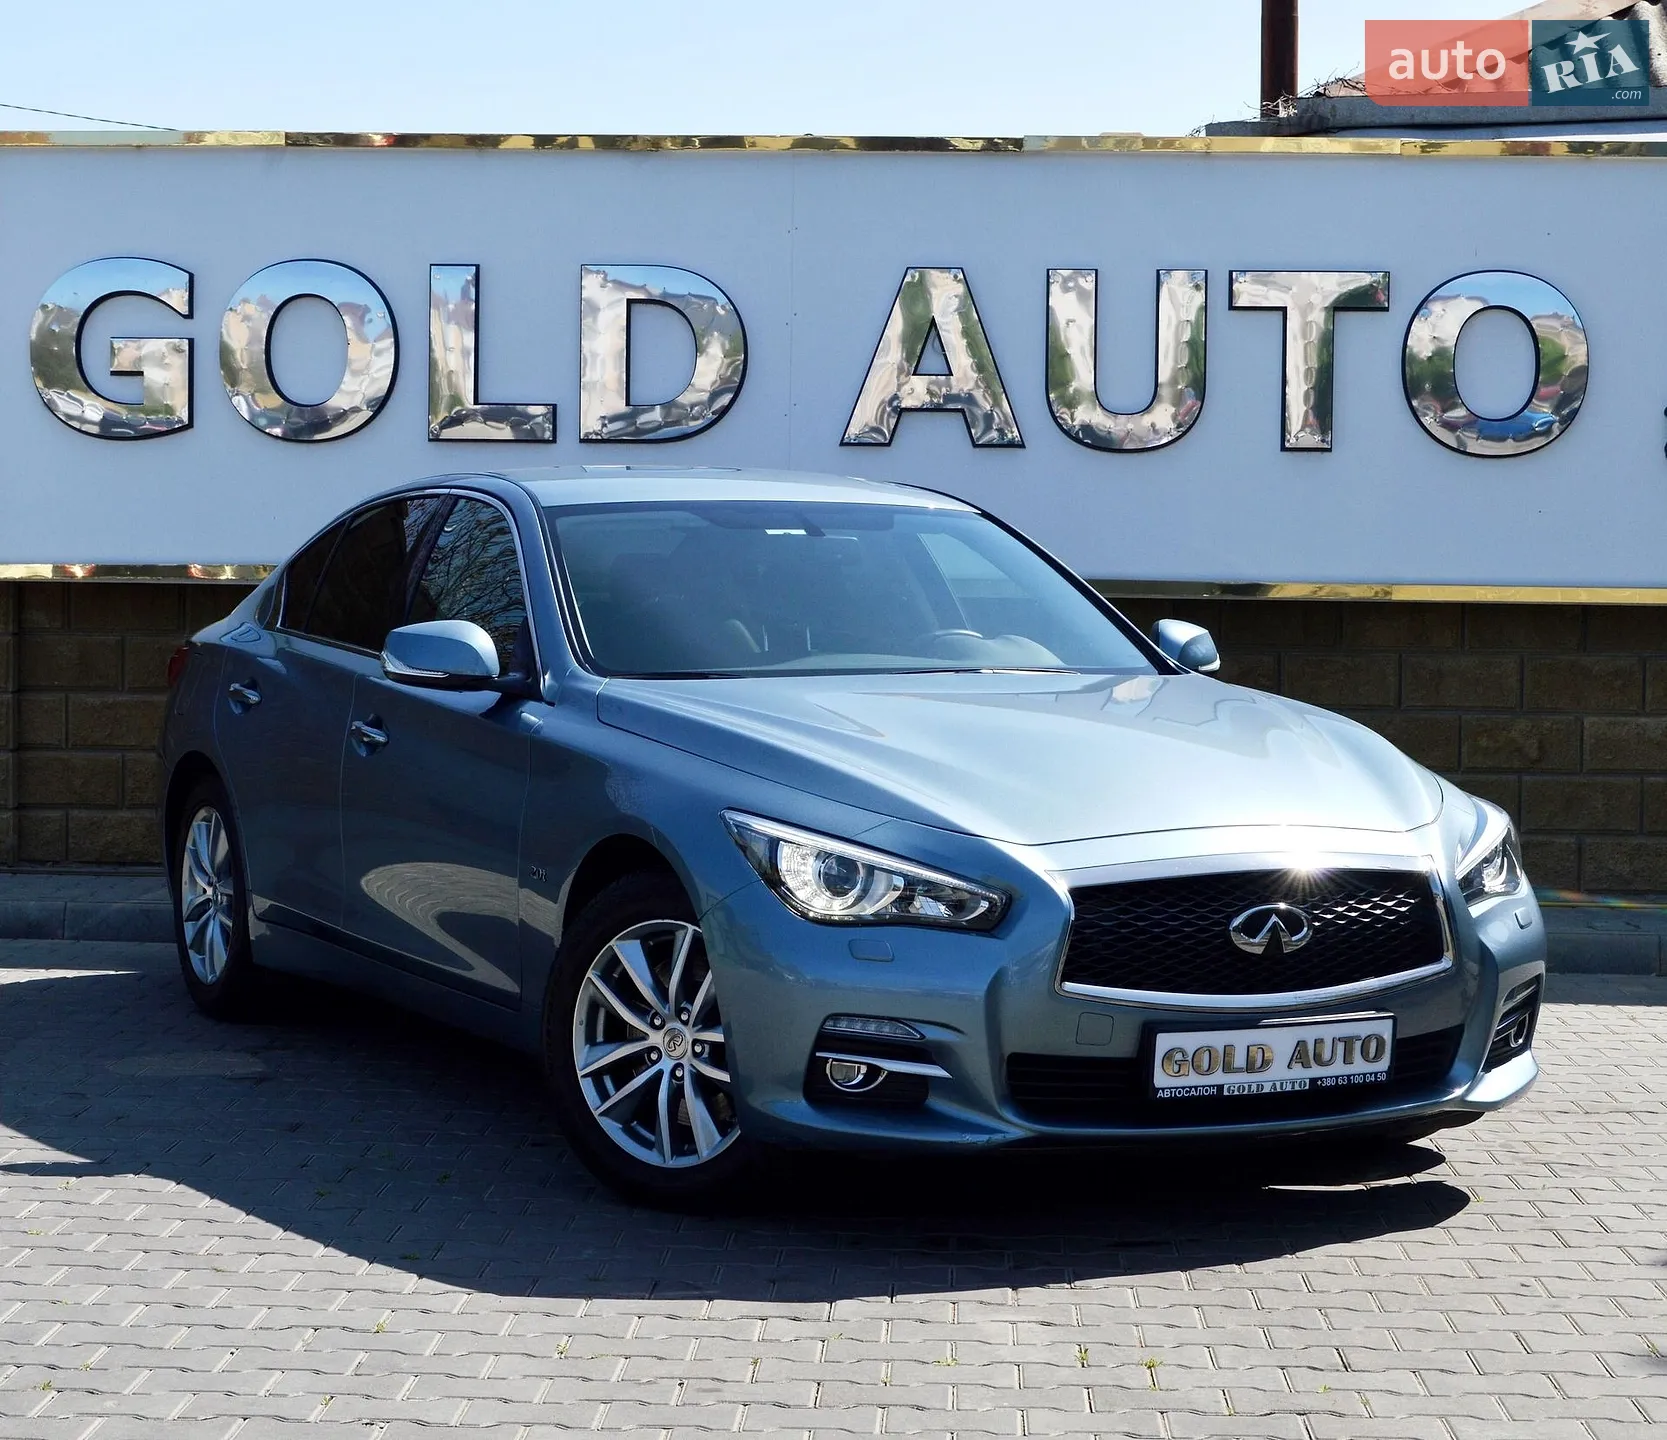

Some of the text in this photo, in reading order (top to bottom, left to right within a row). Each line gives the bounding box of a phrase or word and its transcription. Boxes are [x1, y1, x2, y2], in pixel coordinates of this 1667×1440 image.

[30, 256, 1590, 459] GOLD AUTO
[1162, 1034, 1387, 1077] GOLD AUTO
[1226, 1079, 1308, 1095] GOLD AUTO
[1317, 1072, 1387, 1087] +380 63 100 04 50
[1156, 1086, 1218, 1099] АВТОСАЛОН
